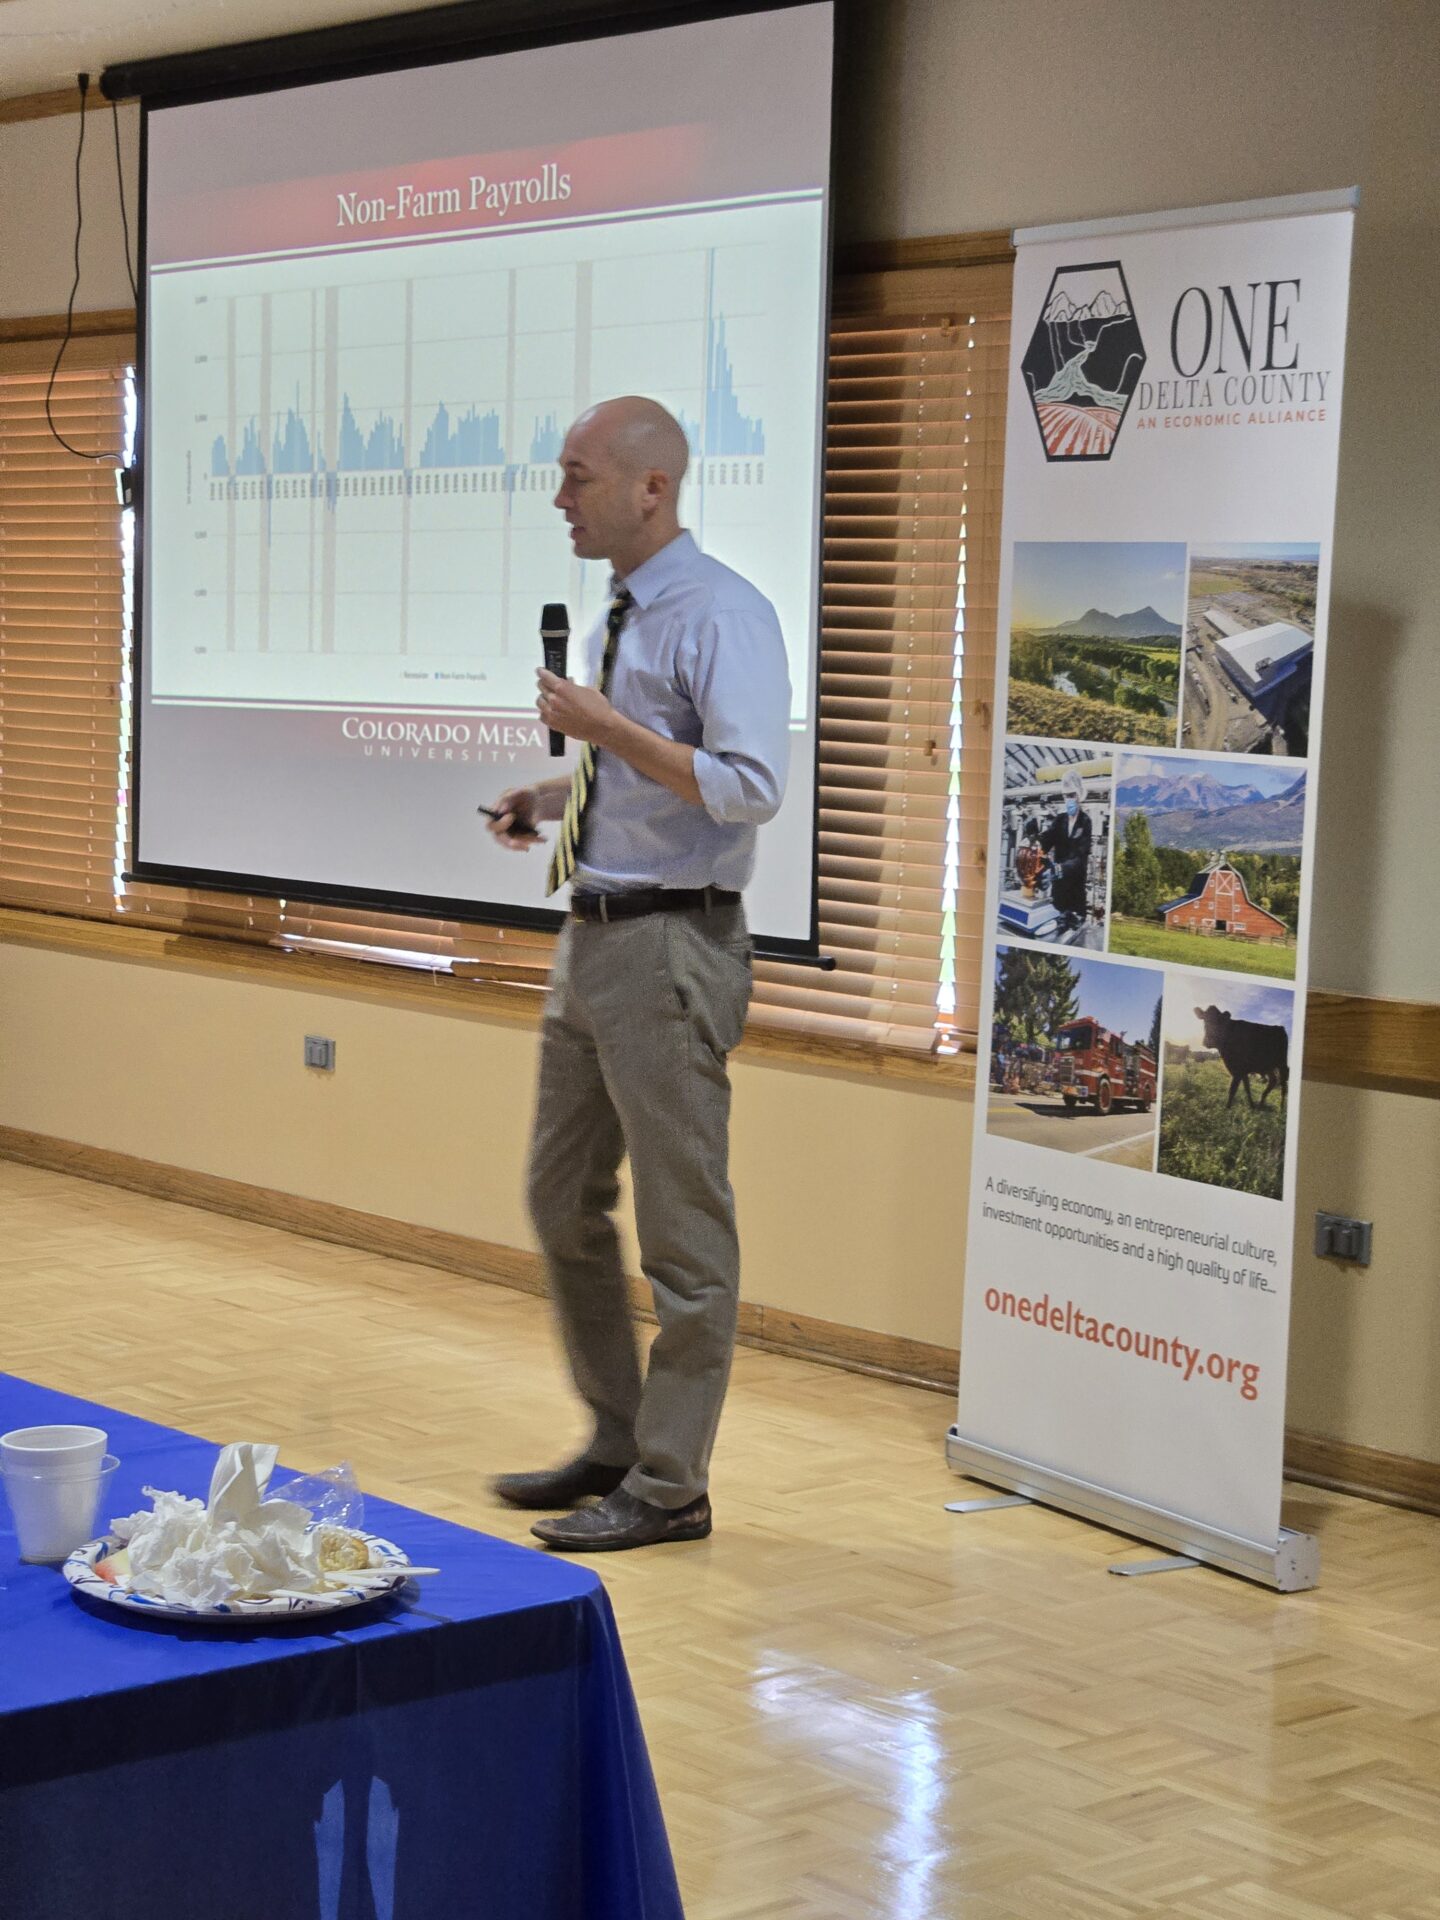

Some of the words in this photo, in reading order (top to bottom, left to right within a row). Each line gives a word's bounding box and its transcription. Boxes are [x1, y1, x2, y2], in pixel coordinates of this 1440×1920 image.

[337, 185, 461, 226] Non-Farm
[469, 163, 571, 216] Payrolls
[1170, 279, 1301, 378] ONE
[1137, 417, 1156, 430] AN
[1164, 413, 1241, 429] ECONOMIC
[1248, 409, 1327, 425] ALLIANCE
[1138, 379, 1213, 410] DELTA
[1224, 371, 1331, 406] COUNTY
[342, 717, 470, 746] COLORADO
[477, 722, 545, 748] MESA
[364, 745, 517, 763] UNIVERSITY
[982, 1202, 1043, 1232] investment
[1045, 1221, 1119, 1253] opportunities
[1122, 1242, 1145, 1260] and
[1147, 1249, 1155, 1262] a
[1157, 1247, 1184, 1271] high
[1186, 1259, 1230, 1285] quality
[1233, 1269, 1248, 1286] of
[985, 1176, 994, 1192] A
[996, 1179, 1059, 1212] diversifying
[1061, 1198, 1114, 1227] economy,
[1117, 1212, 1132, 1227] an
[1135, 1217, 1229, 1251] entrepreneurial
[1232, 1239, 1277, 1267] culture,
[985, 1288, 1260, 1401] onedeltacounty.org
